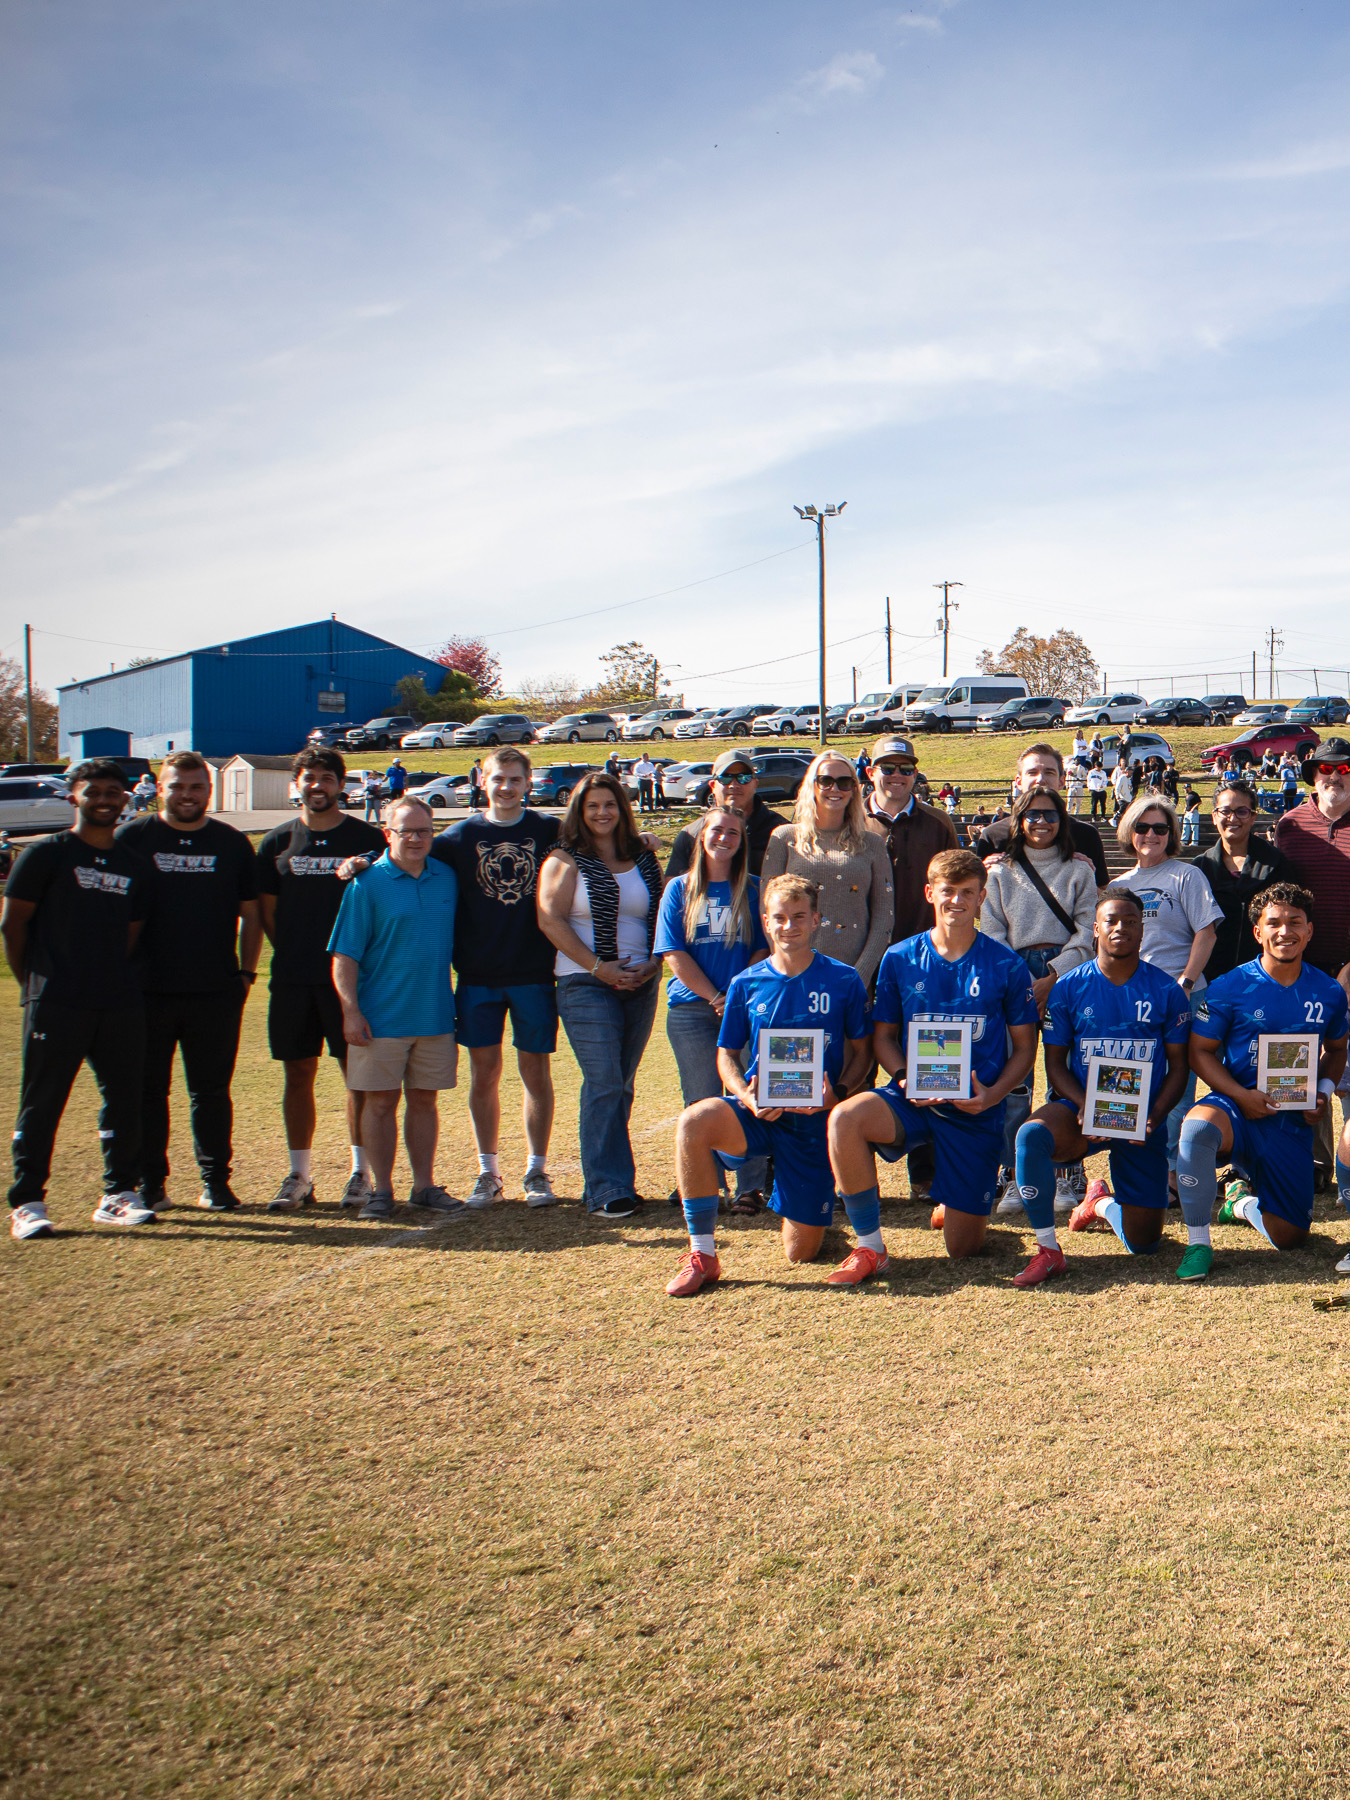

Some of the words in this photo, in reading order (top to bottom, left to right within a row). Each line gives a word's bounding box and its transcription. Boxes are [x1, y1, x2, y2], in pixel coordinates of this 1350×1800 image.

[175, 855, 217, 866] TWU
[969, 976, 980, 997] 6
[808, 991, 830, 1014] 30
[1135, 1000, 1152, 1023] 12
[1304, 1001, 1325, 1023] 22
[1080, 1037, 1157, 1066] TWU
